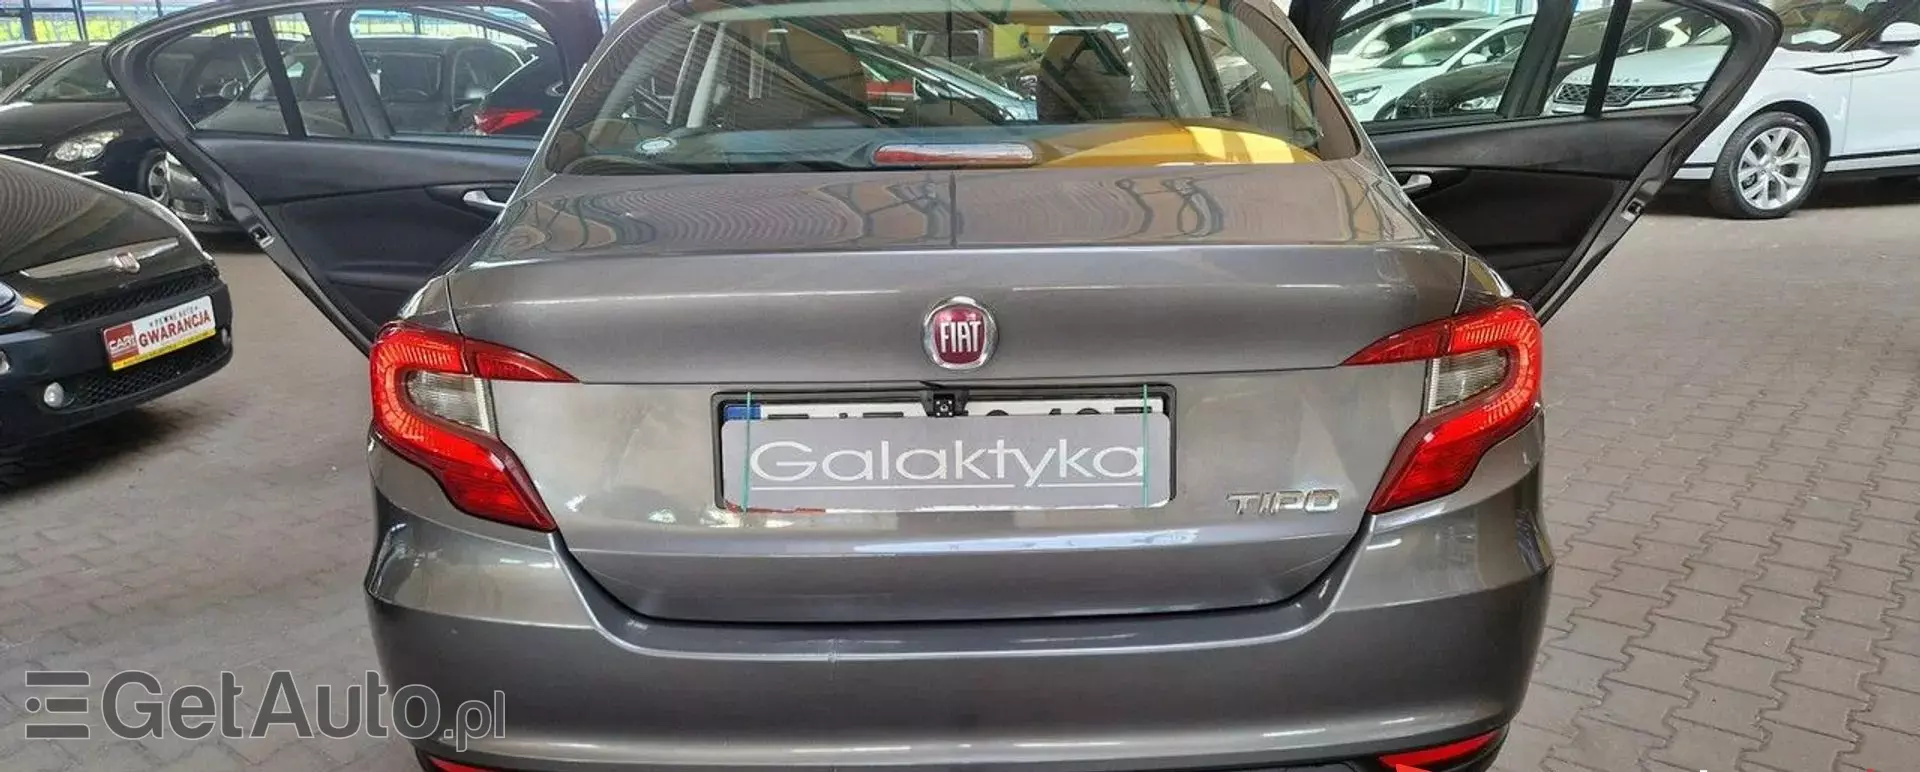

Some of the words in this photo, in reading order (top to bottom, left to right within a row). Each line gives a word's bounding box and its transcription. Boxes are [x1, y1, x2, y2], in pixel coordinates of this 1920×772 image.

[139, 310, 212, 348] GWARANCJA
[940, 320, 982, 353] FIAT
[749, 438, 1145, 488] Galaktyka
[1225, 489, 1340, 515] TIPO
